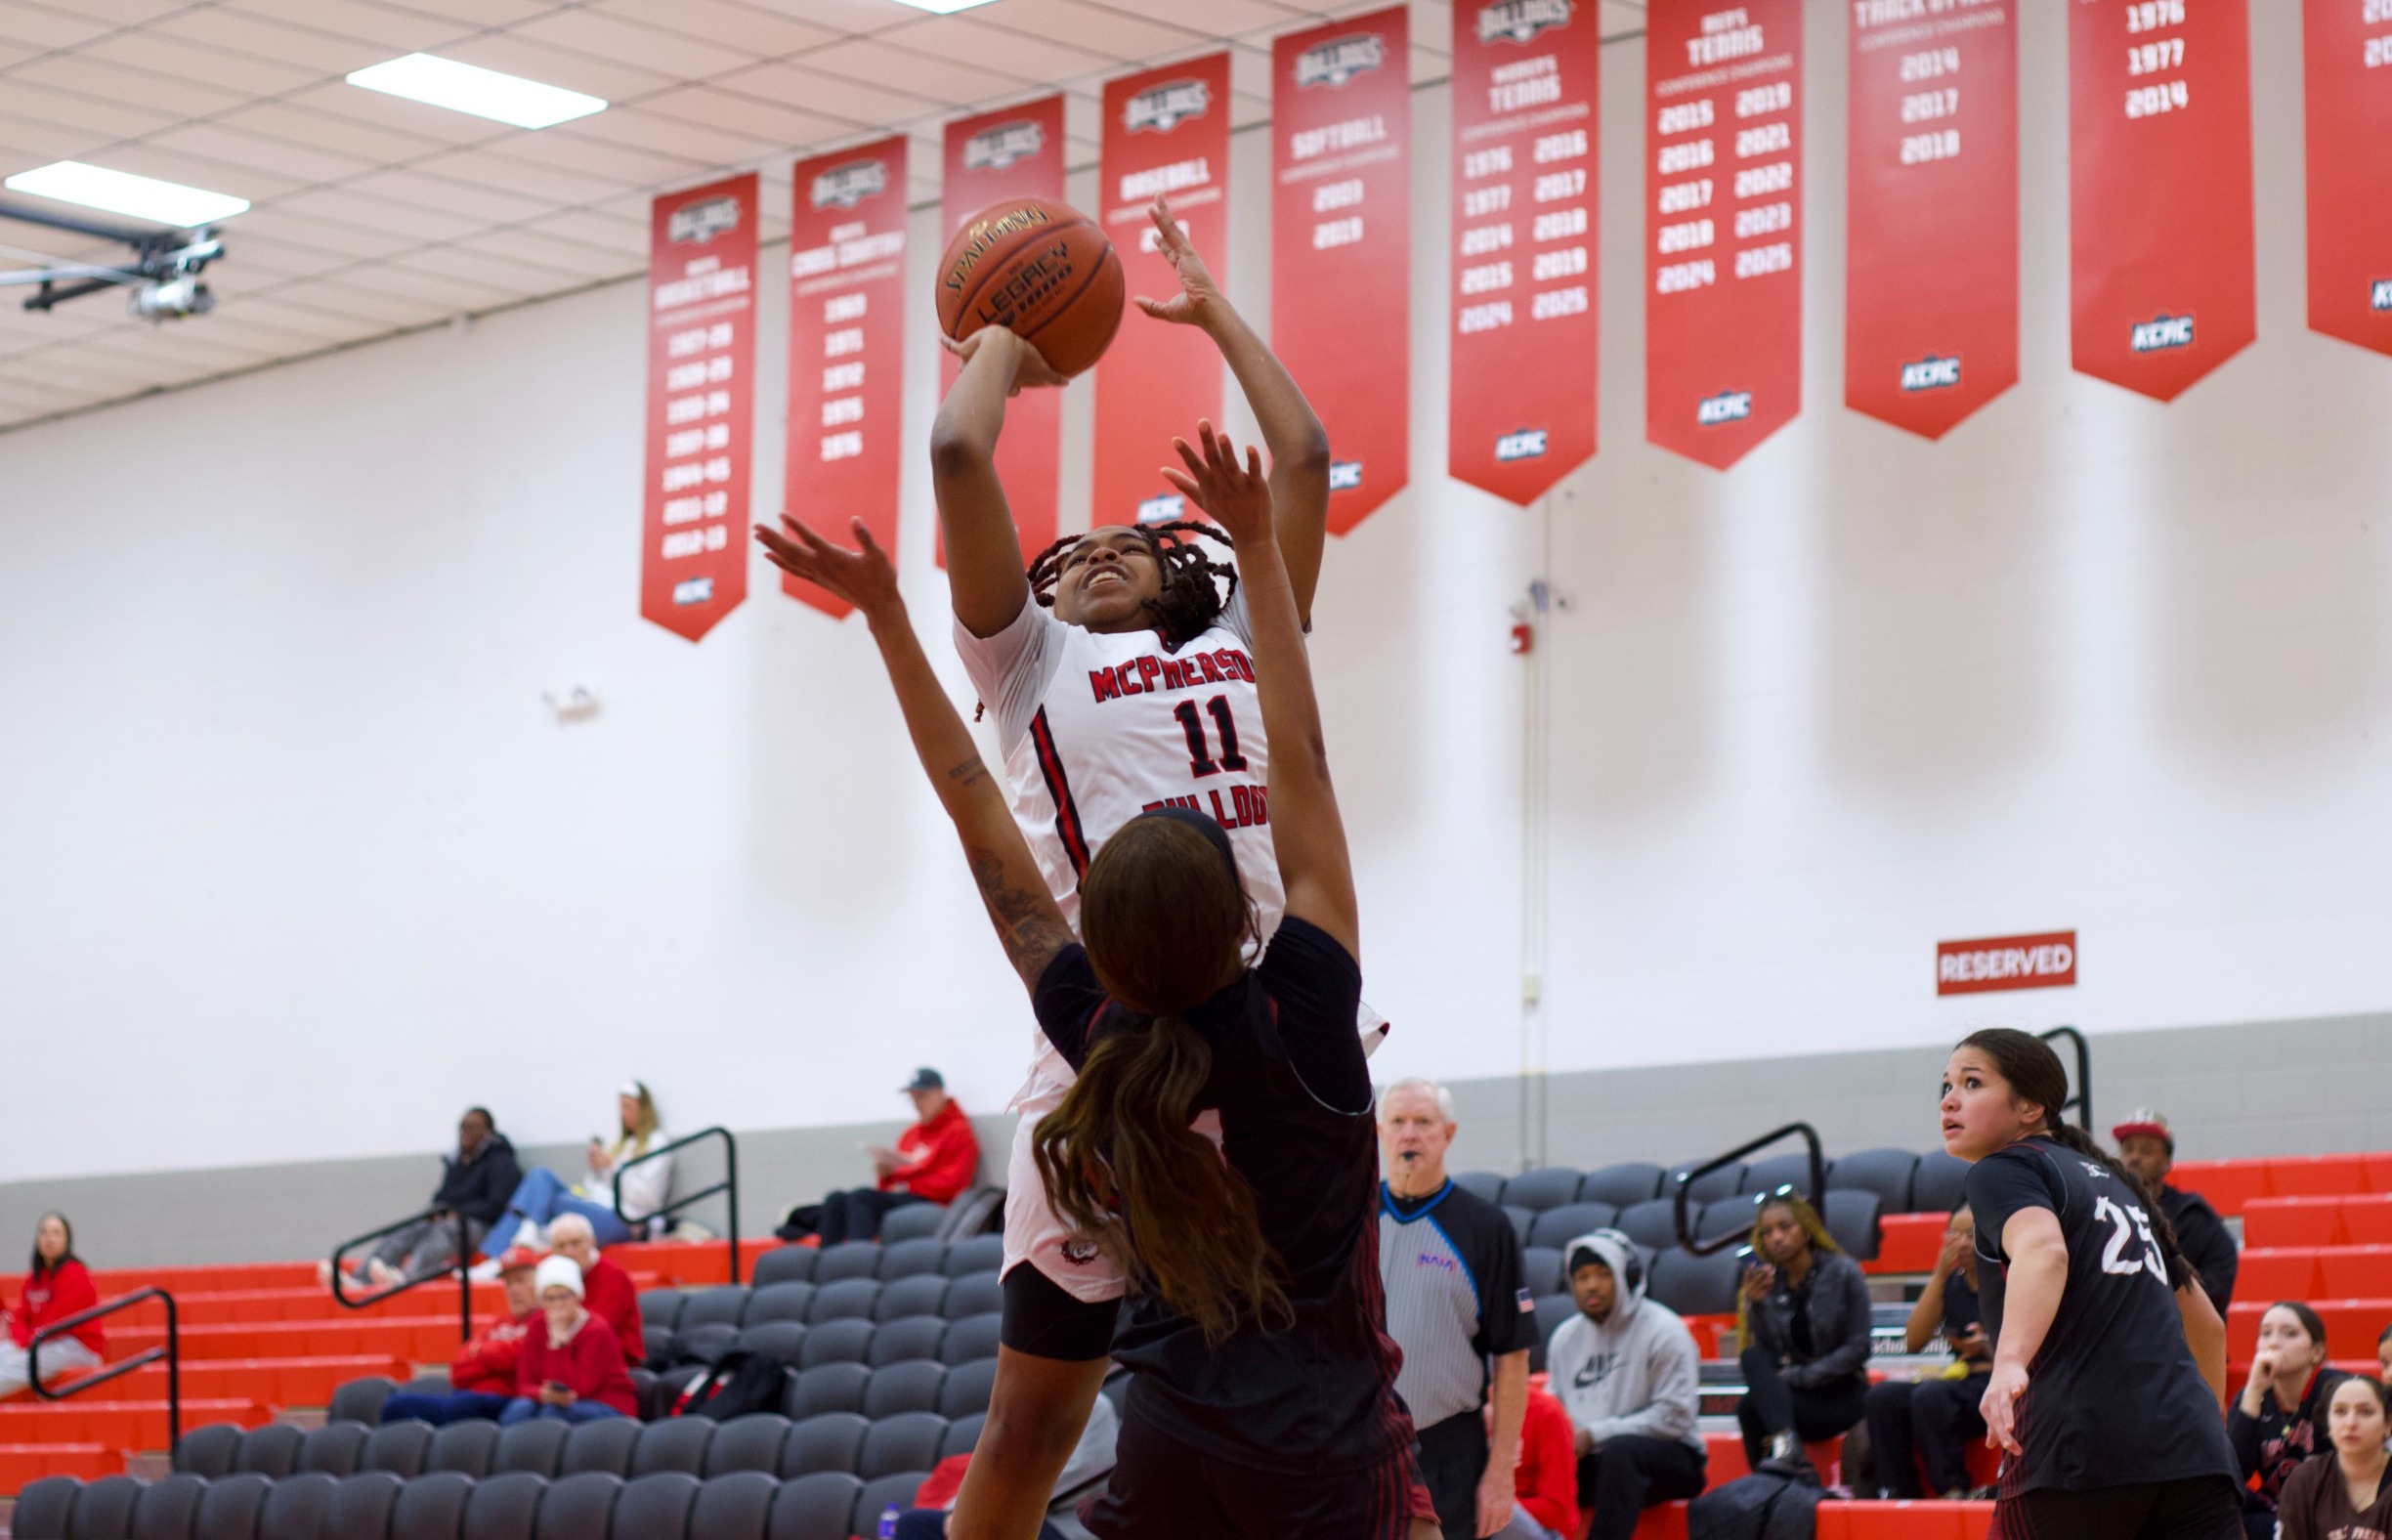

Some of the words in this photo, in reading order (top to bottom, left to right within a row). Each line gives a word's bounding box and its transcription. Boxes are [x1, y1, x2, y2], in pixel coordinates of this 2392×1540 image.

[2126, 0, 2185, 33] 1976
[1686, 24, 1764, 67] TENNIS
[1900, 47, 1959, 83] 2014
[2127, 37, 2185, 76] 1977
[1488, 74, 1561, 113] TENNIS
[1901, 87, 1959, 123] 2017
[2124, 79, 2188, 119] 2014
[1291, 114, 1387, 159] SOFTBALL
[1658, 99, 1714, 135] 2015
[1735, 122, 1791, 158] 2021
[1465, 184, 1511, 218] 1977
[1535, 168, 1586, 202] 2017
[1658, 179, 1713, 215] 2017
[946, 204, 1050, 296] SPALDING
[1462, 223, 1513, 257] 2014
[978, 240, 1069, 324] LEGACY
[1656, 259, 1716, 294] 2024
[1734, 241, 1792, 279] 2025
[1089, 648, 1256, 704] MCPHERSO
[1174, 695, 1248, 779] 11
[1940, 943, 2073, 983] RESERVED
[2094, 1195, 2168, 1286] 25
